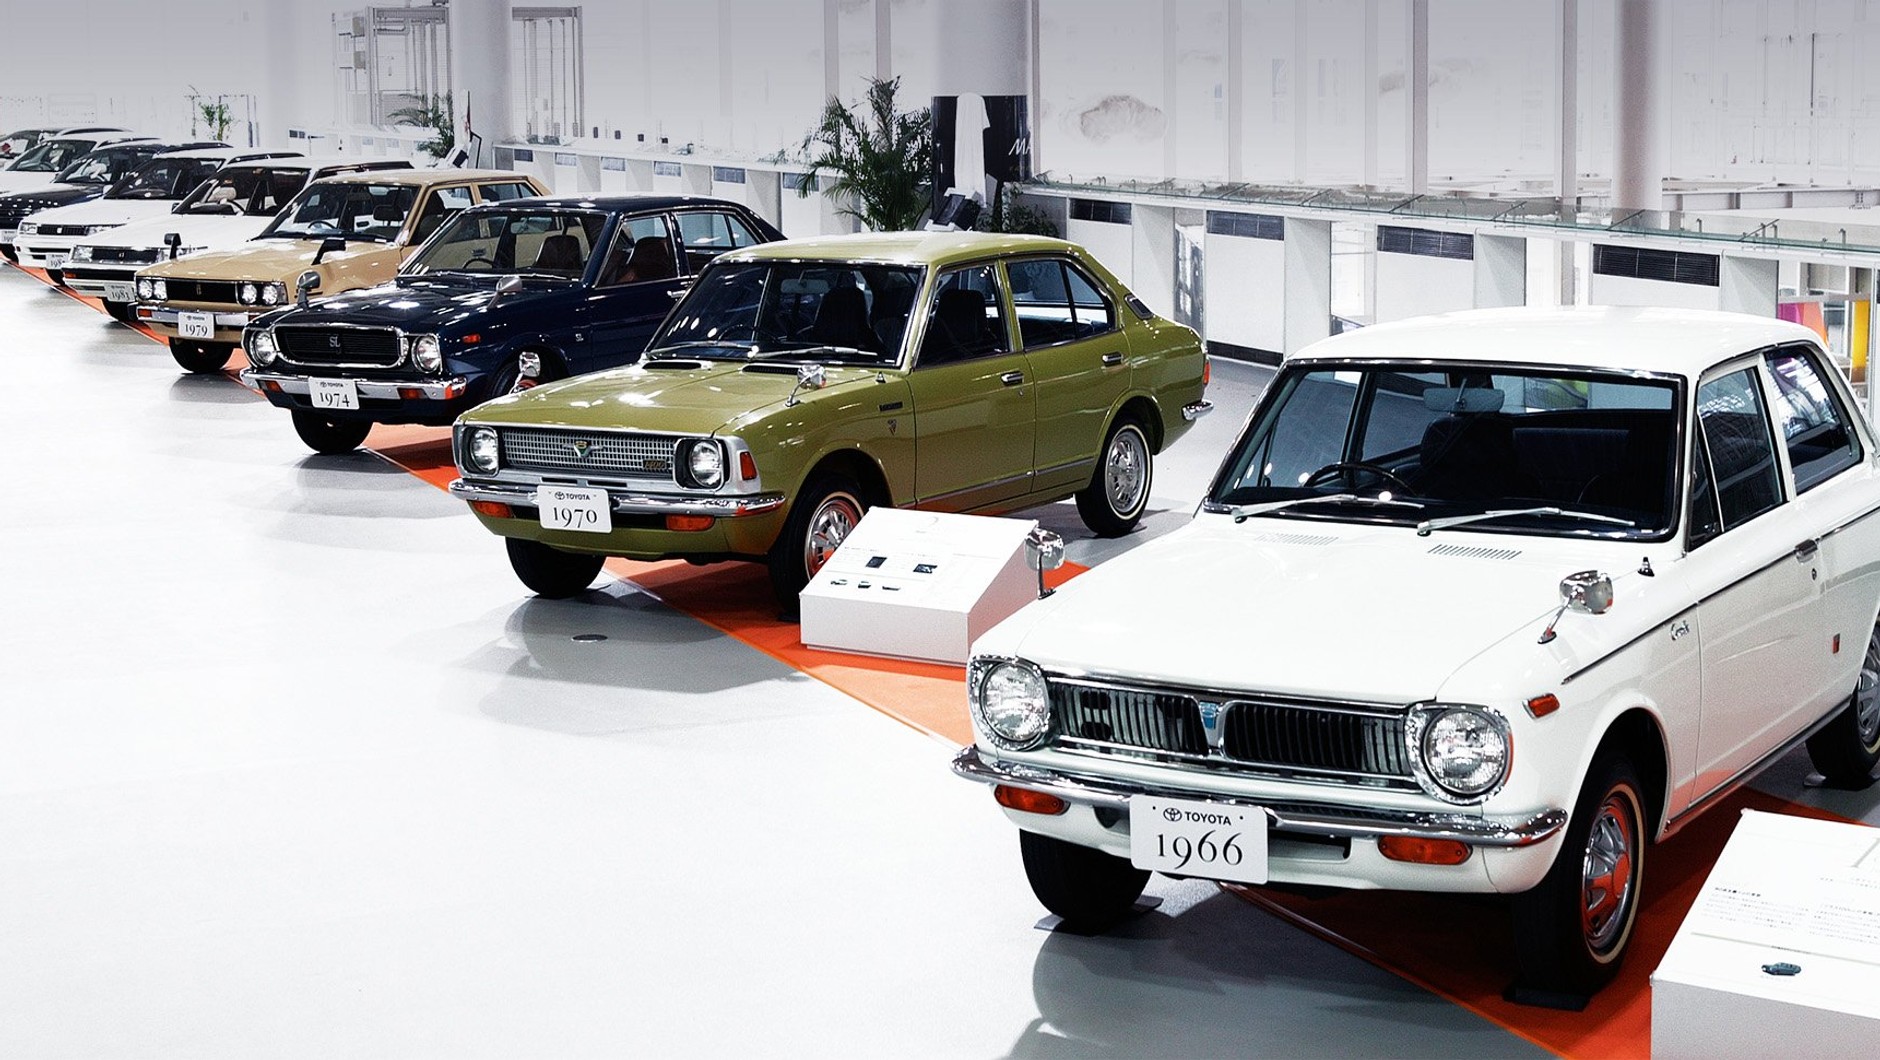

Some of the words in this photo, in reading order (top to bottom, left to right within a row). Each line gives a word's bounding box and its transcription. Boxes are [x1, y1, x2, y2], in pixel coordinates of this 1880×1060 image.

[185, 324, 208, 336] 1979
[329, 336, 340, 347] SL
[320, 392, 350, 407] 1974
[553, 507, 597, 528] 1970
[1185, 811, 1231, 826] TOYOTA
[1157, 830, 1243, 869] 1966
